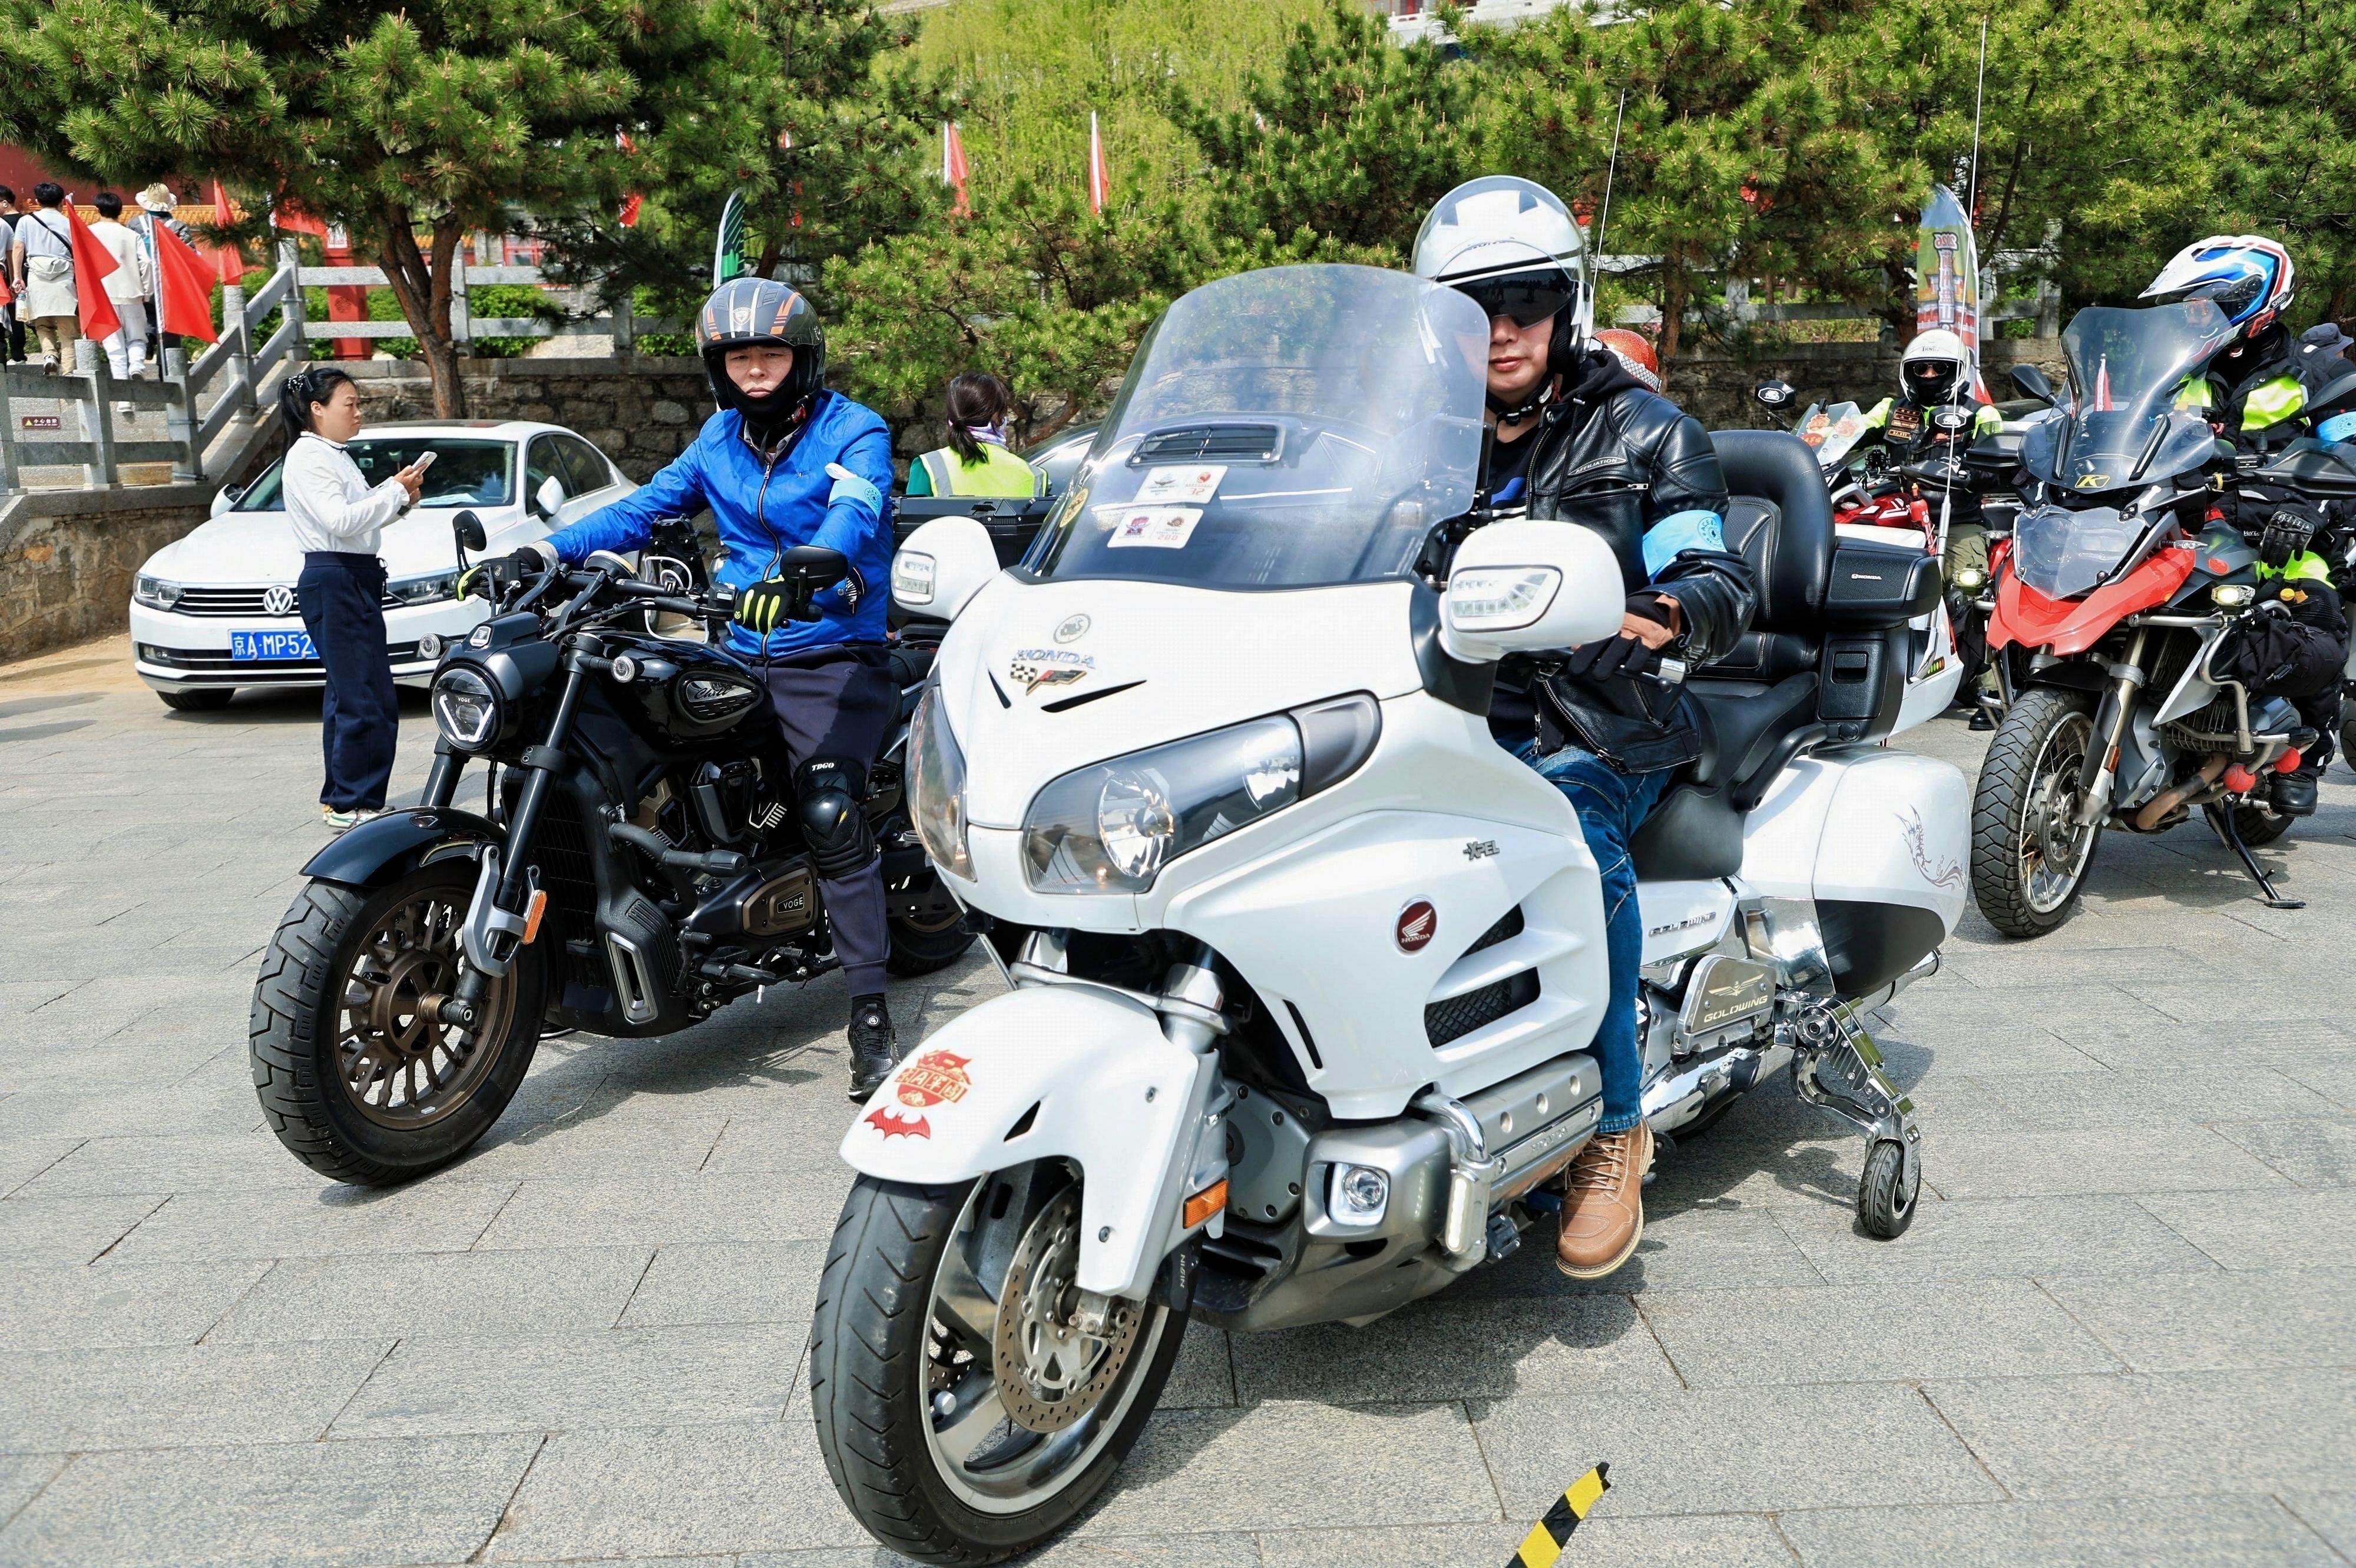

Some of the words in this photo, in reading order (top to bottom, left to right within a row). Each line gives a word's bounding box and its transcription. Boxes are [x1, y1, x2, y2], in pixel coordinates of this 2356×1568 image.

[1575, 458, 1617, 474] AFFILIATION
[233, 634, 317, 656] 京A·MP52
[1012, 649, 1096, 669] HONDA
[694, 687, 732, 700] Chill
[811, 762, 835, 772] TDGO
[783, 897, 803, 909] VOGE
[1401, 933, 1431, 943] HONDA
[1703, 994, 1769, 1023] GOLDWING
